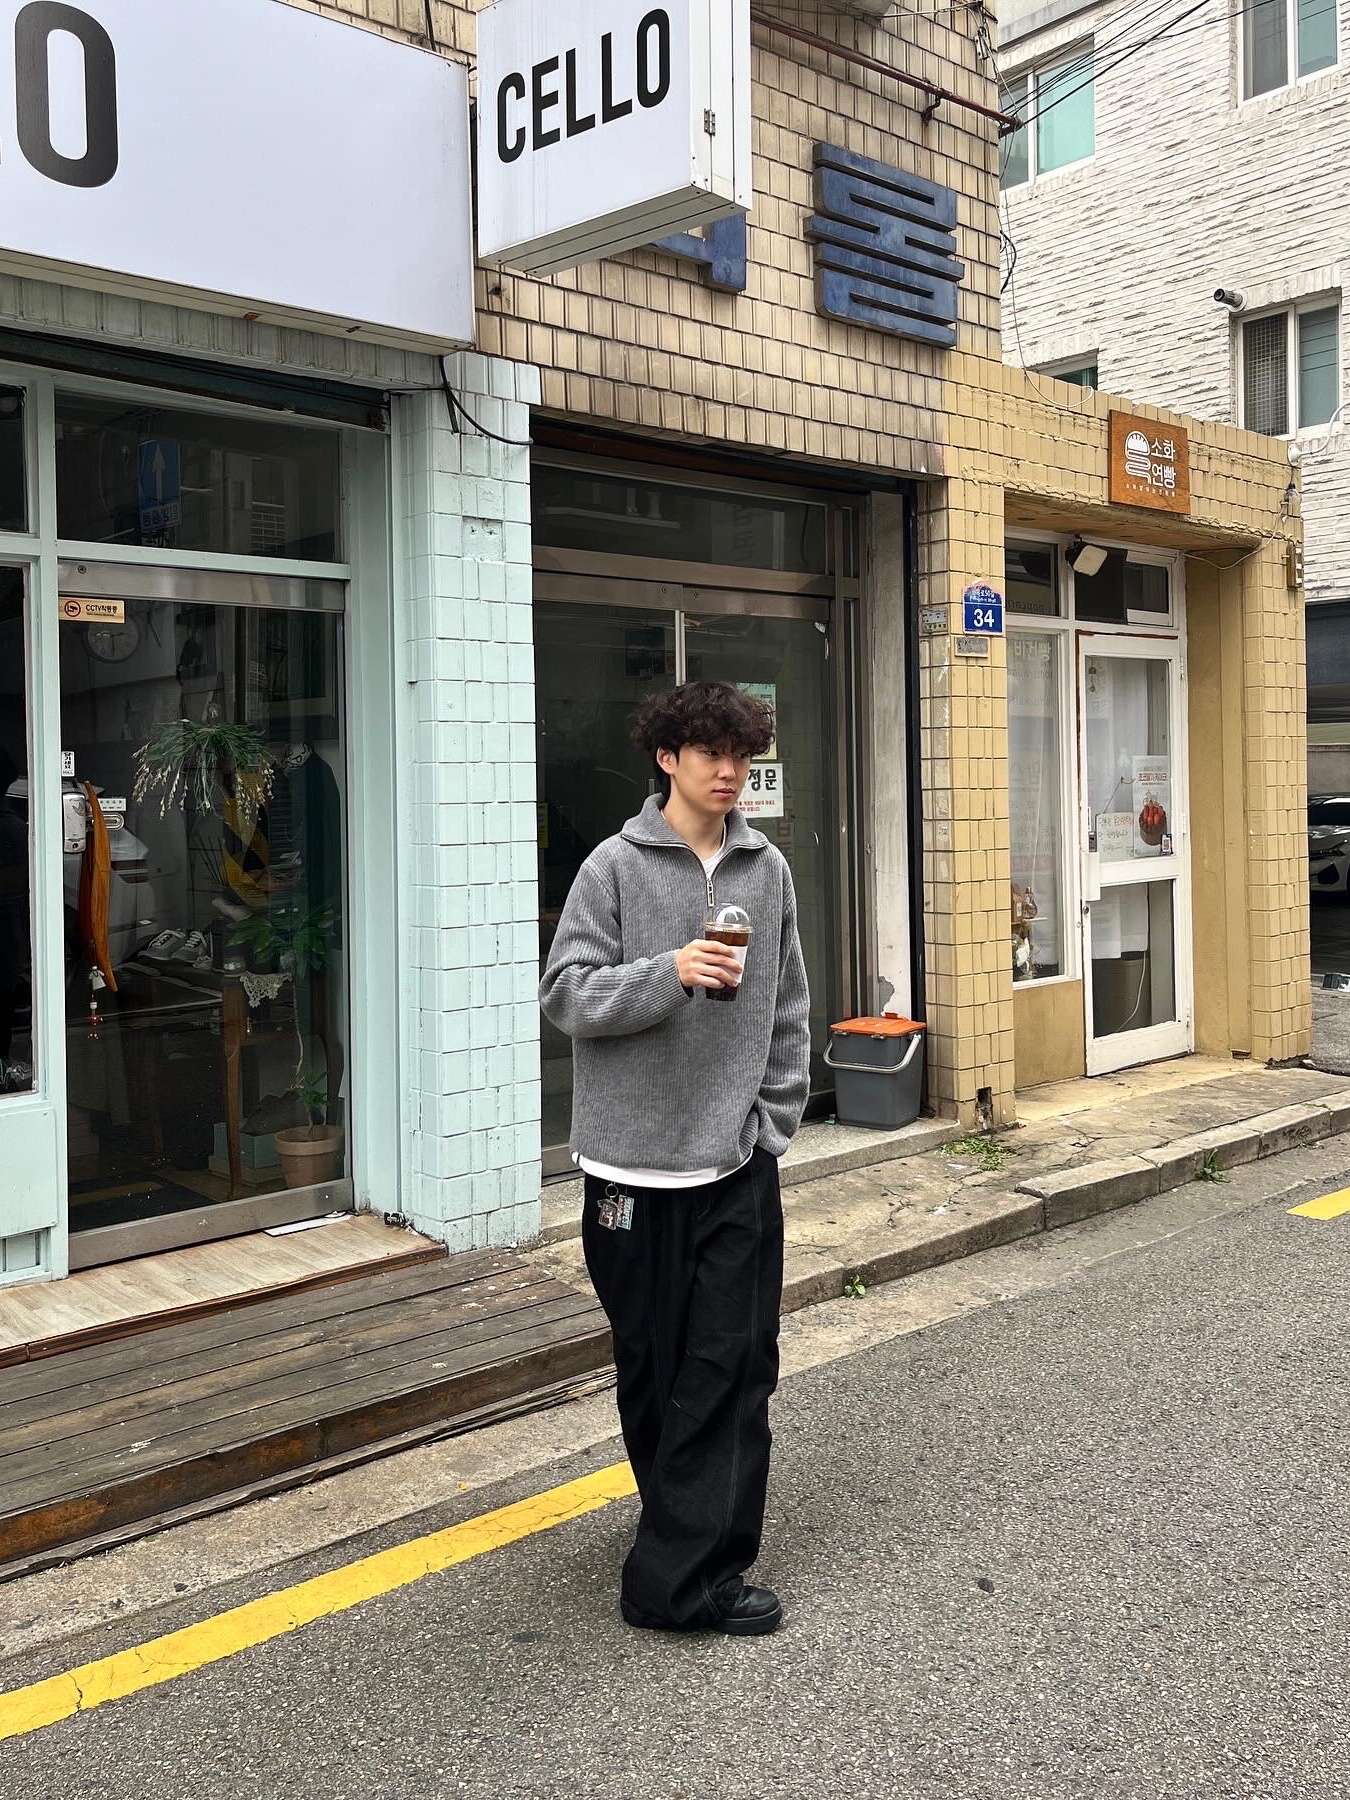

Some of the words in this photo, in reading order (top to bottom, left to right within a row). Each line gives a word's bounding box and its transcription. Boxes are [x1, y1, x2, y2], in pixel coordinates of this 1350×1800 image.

[0, 1, 118, 188] O
[497, 8, 671, 163] CELLO
[1150, 437, 1176, 462] 소화
[1151, 463, 1177, 489] 연빵
[973, 608, 995, 628] 34
[748, 768, 778, 791] 정문
